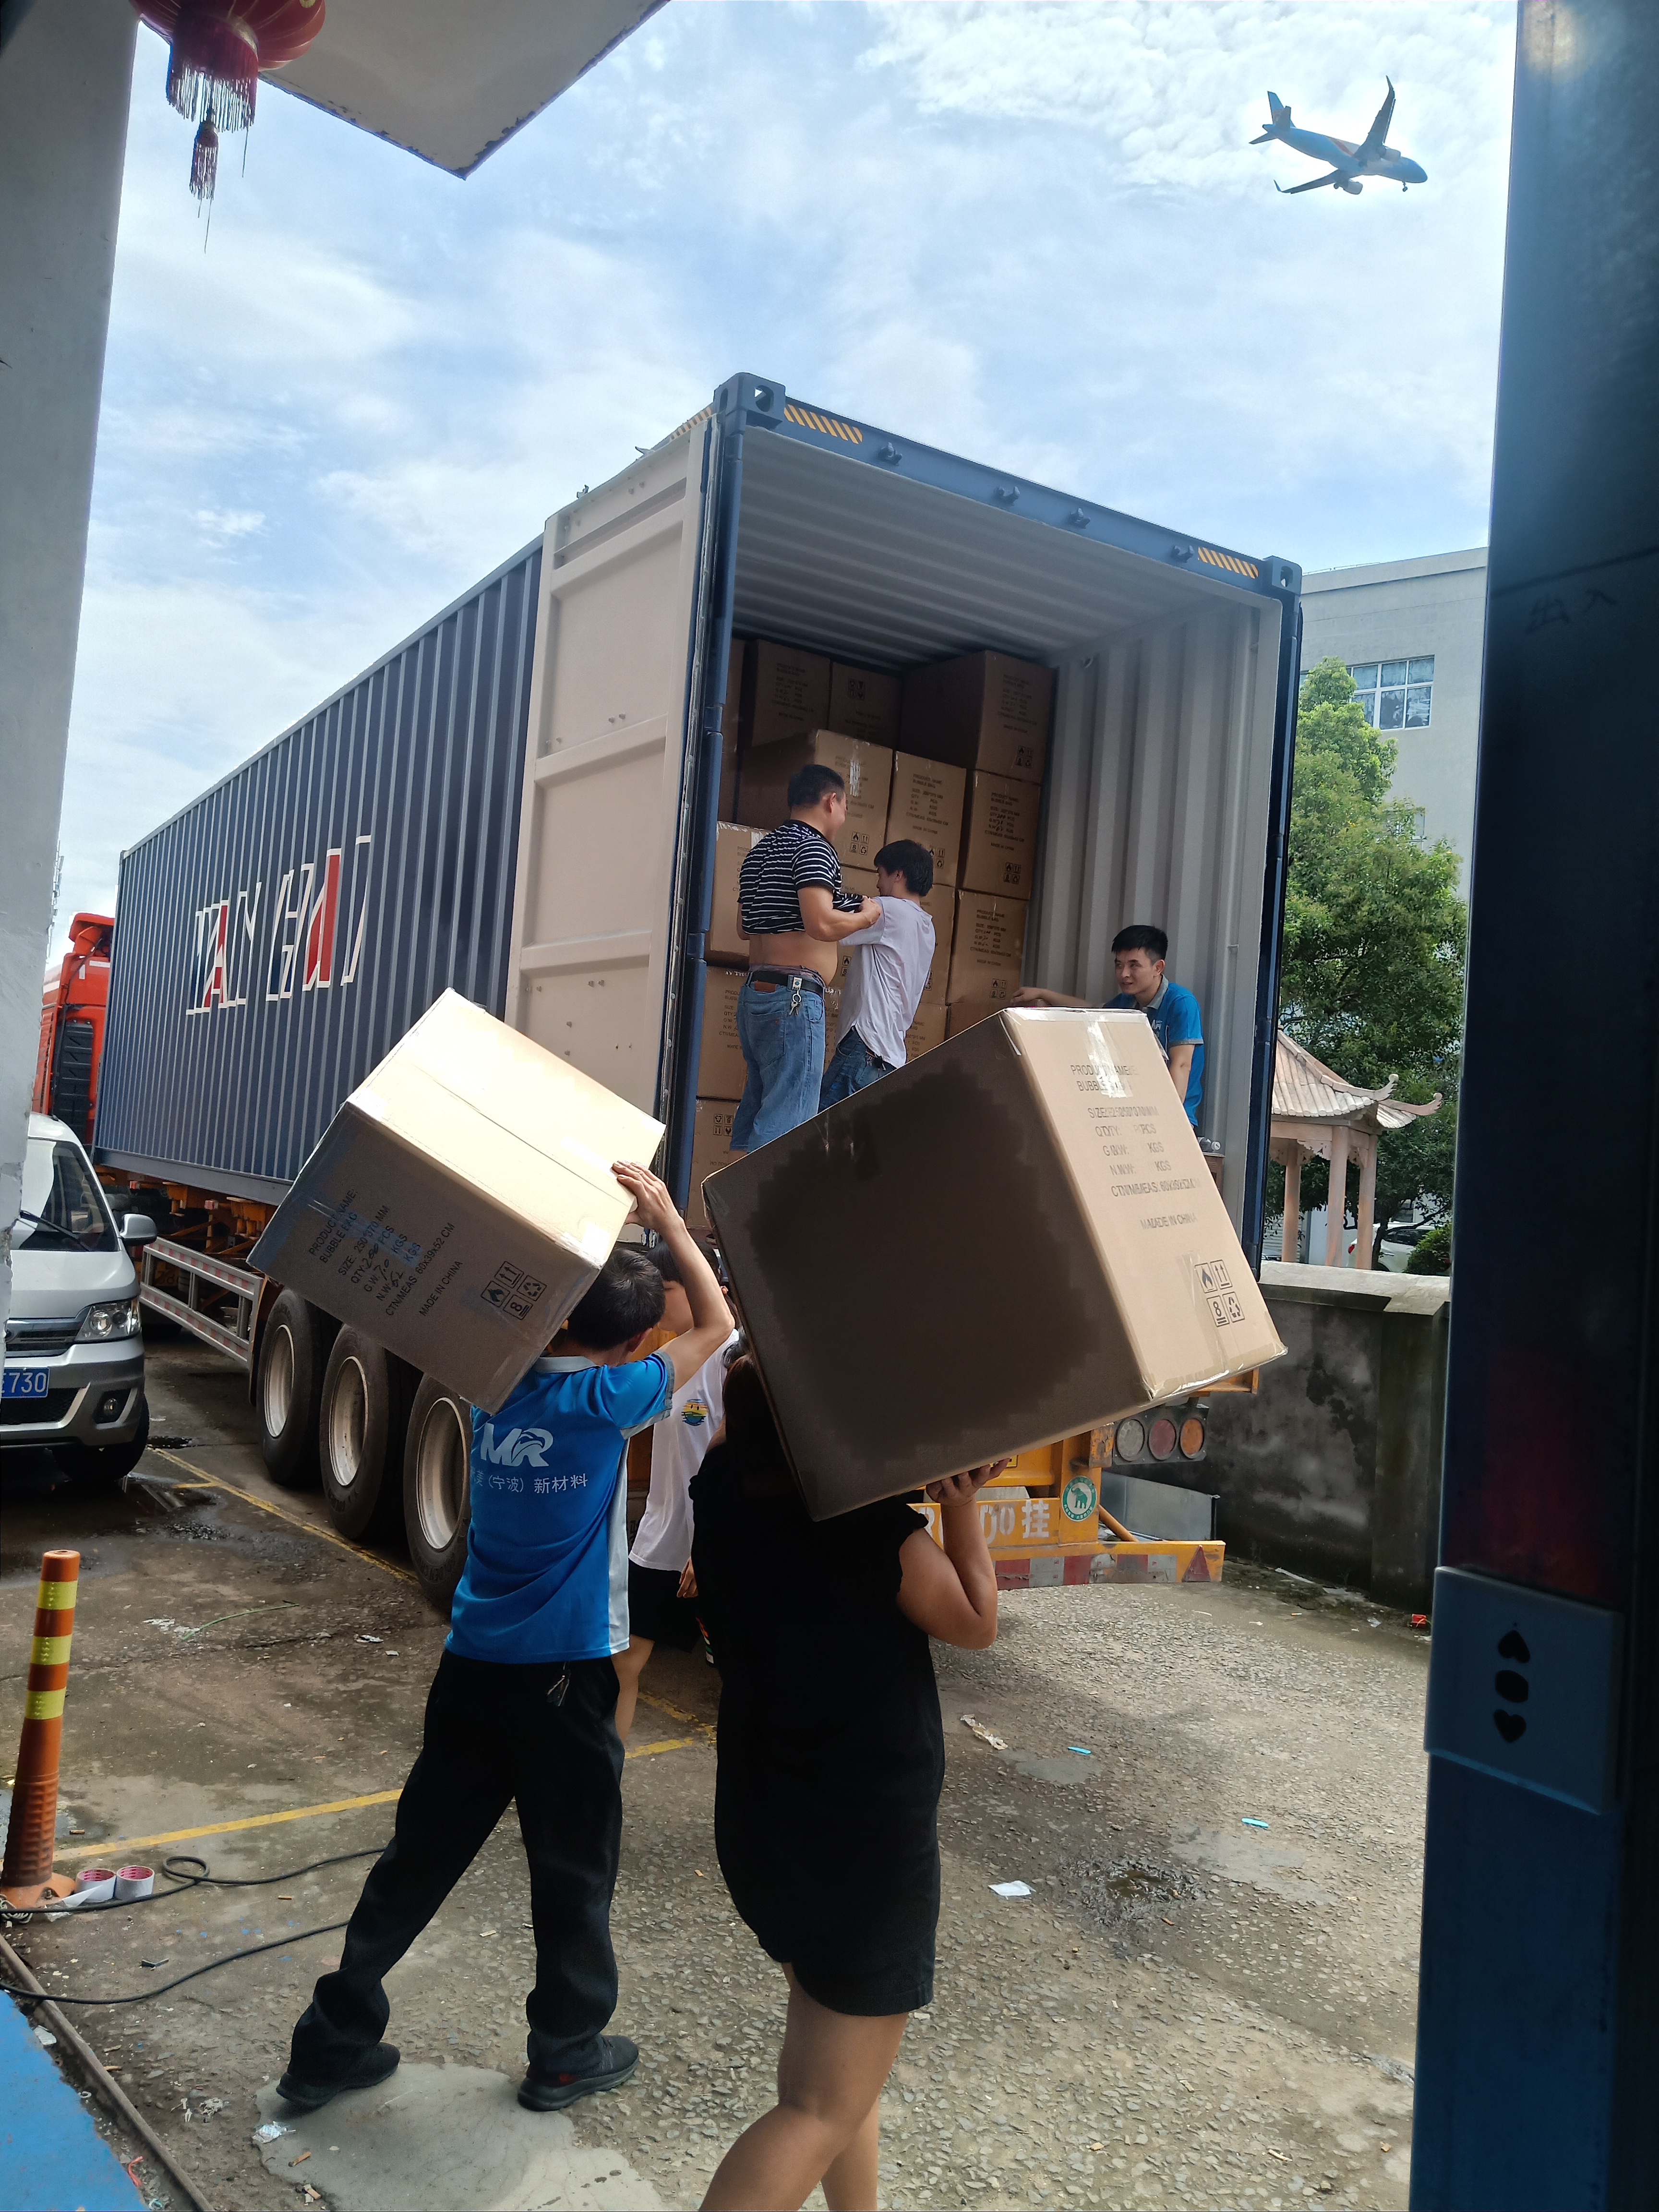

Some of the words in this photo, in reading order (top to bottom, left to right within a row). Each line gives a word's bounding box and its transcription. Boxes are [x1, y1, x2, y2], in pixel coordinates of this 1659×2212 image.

[440, 1222, 455, 1238] CM
[319, 1230, 346, 1263] BUBBLE
[391, 1233, 408, 1254] KGS
[419, 1293, 439, 1317] MADE
[434, 1284, 445, 1294] IN
[441, 1259, 463, 1286] CHINA
[2, 1372, 47, 1393] 730
[534, 1473, 588, 1494] 新材料
